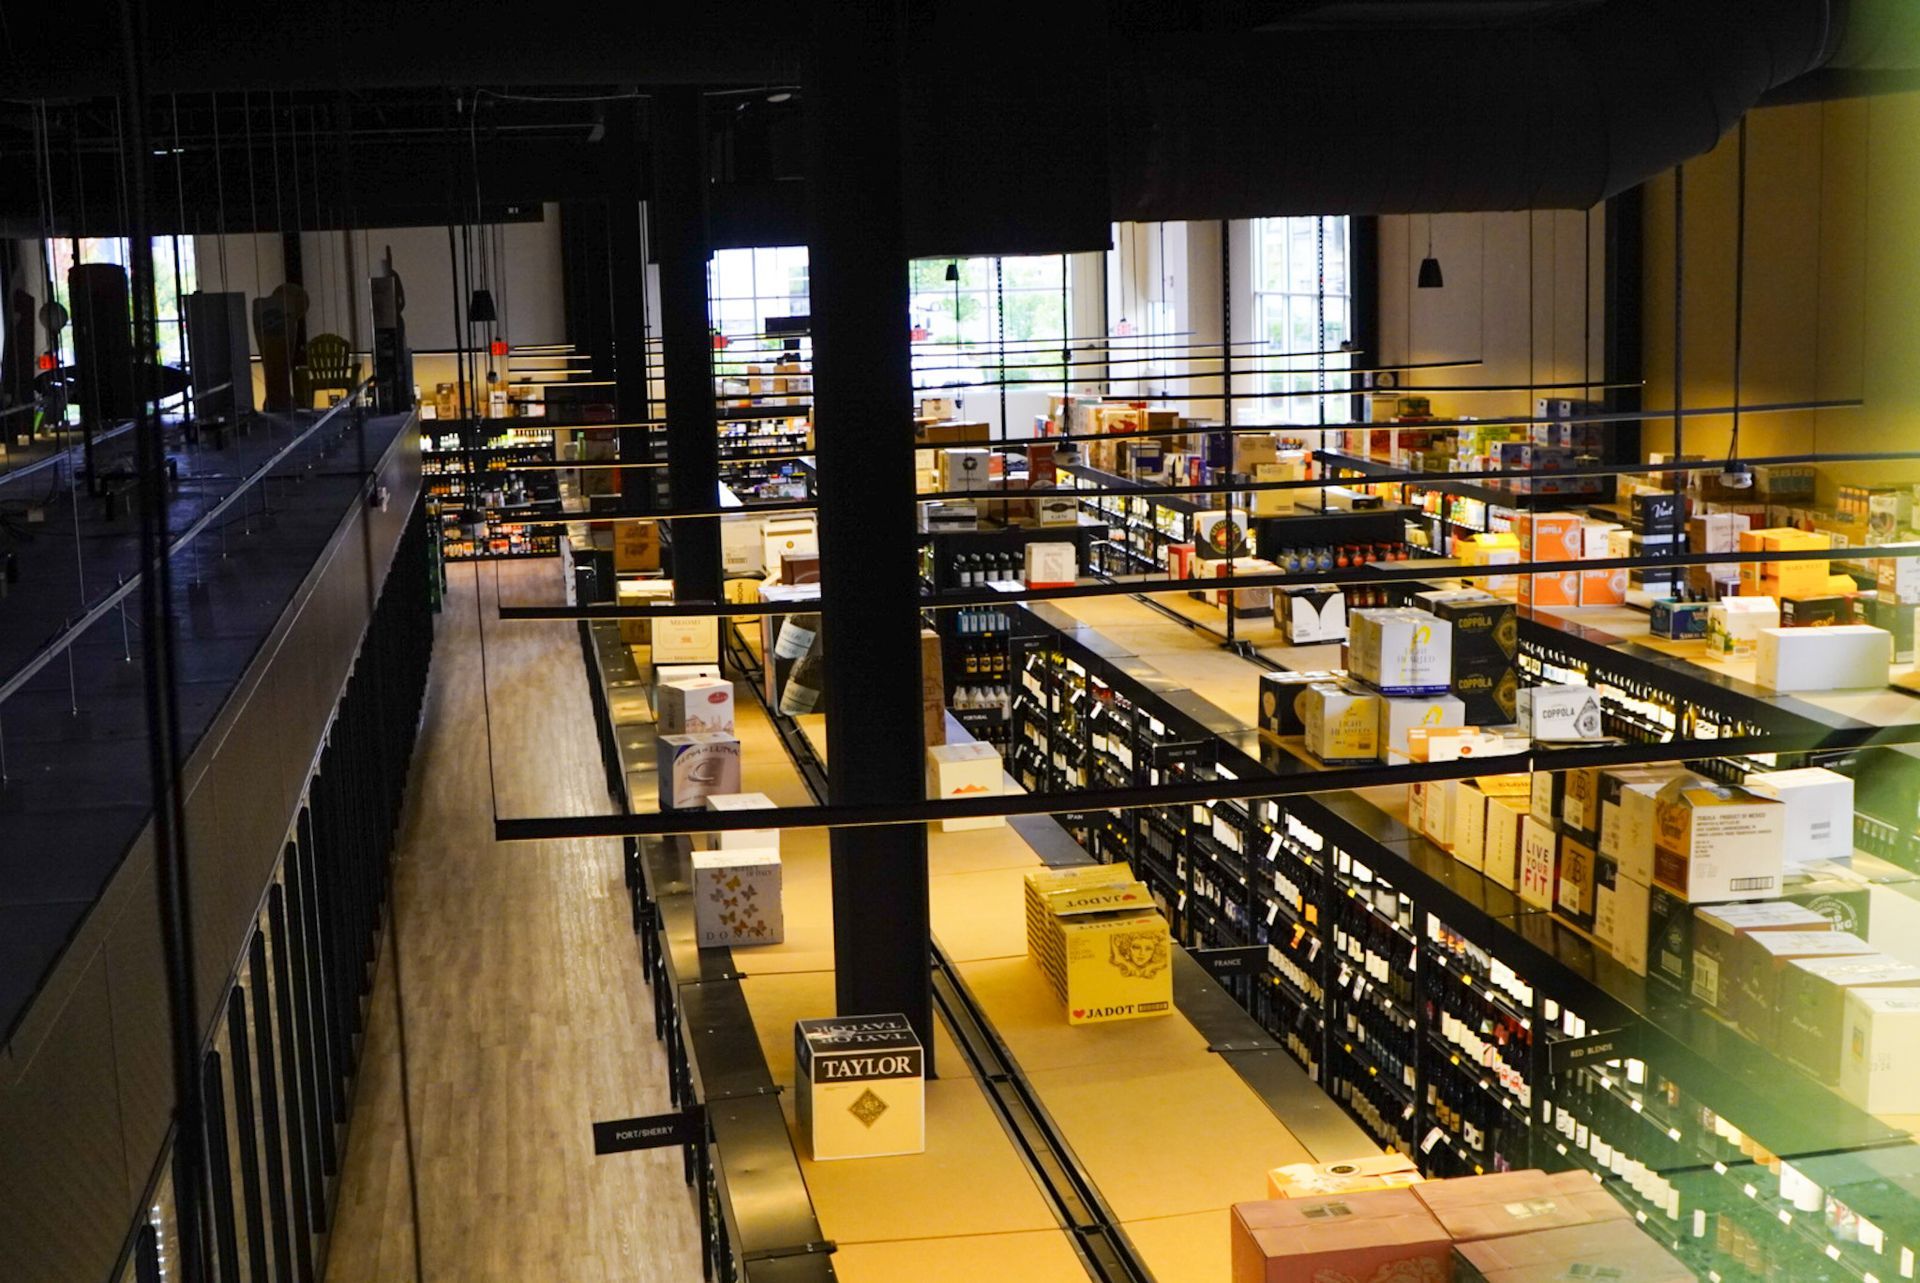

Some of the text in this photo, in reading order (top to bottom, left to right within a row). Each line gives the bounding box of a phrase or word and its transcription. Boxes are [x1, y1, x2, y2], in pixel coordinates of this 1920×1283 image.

[1458, 616, 1493, 629] COPPOLA
[1458, 677, 1493, 690] COPPOLA
[1542, 707, 1576, 719] COPPOLA
[1526, 839, 1549, 864] LIVE
[1526, 855, 1549, 876] YOUR
[1524, 868, 1548, 896] FIT
[1214, 958, 1242, 967] FRANCE
[1086, 1004, 1135, 1019] JADOT
[1570, 1043, 1613, 1058] RED BLENDS
[822, 1056, 912, 1078] TAYLOR
[616, 1126, 674, 1140] PORT/SHERRY
